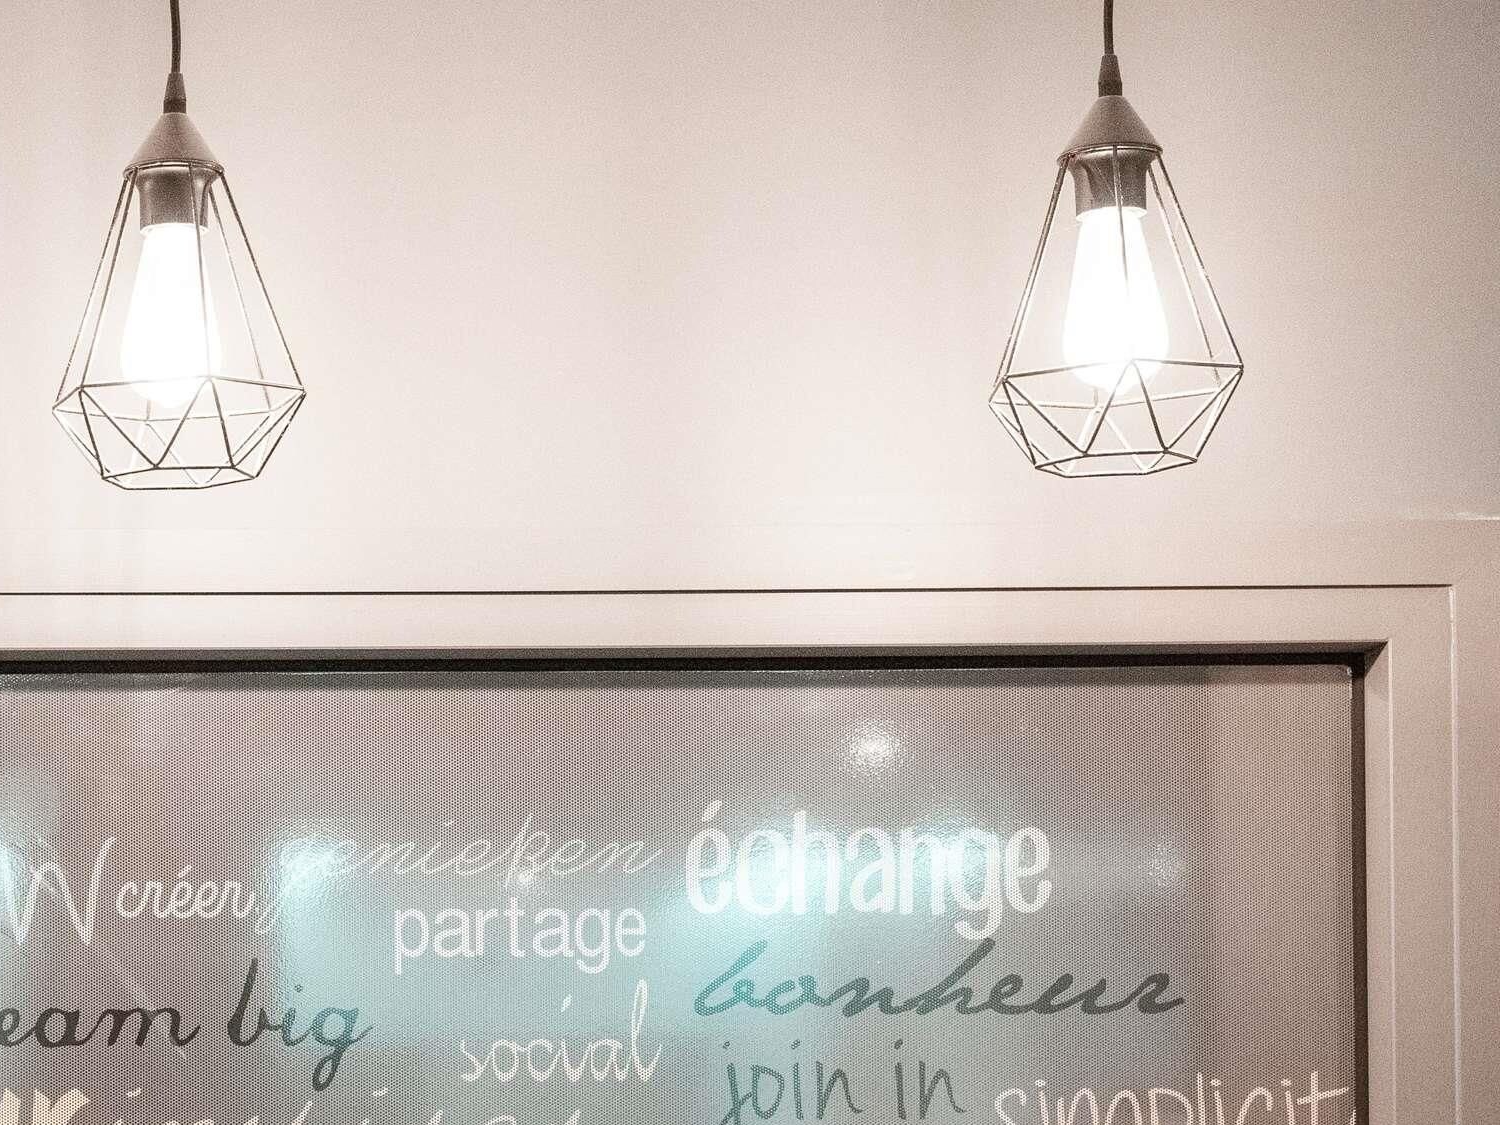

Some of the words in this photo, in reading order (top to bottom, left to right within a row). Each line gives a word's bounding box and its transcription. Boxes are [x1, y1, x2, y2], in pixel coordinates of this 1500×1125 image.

[116, 864, 255, 919] créer
[685, 800, 1053, 940] échange
[394, 896, 648, 975] partage
[694, 937, 1186, 1018] bonheur
[227, 957, 373, 1091] big
[459, 979, 662, 1083] social
[892, 1040, 968, 1120] in
